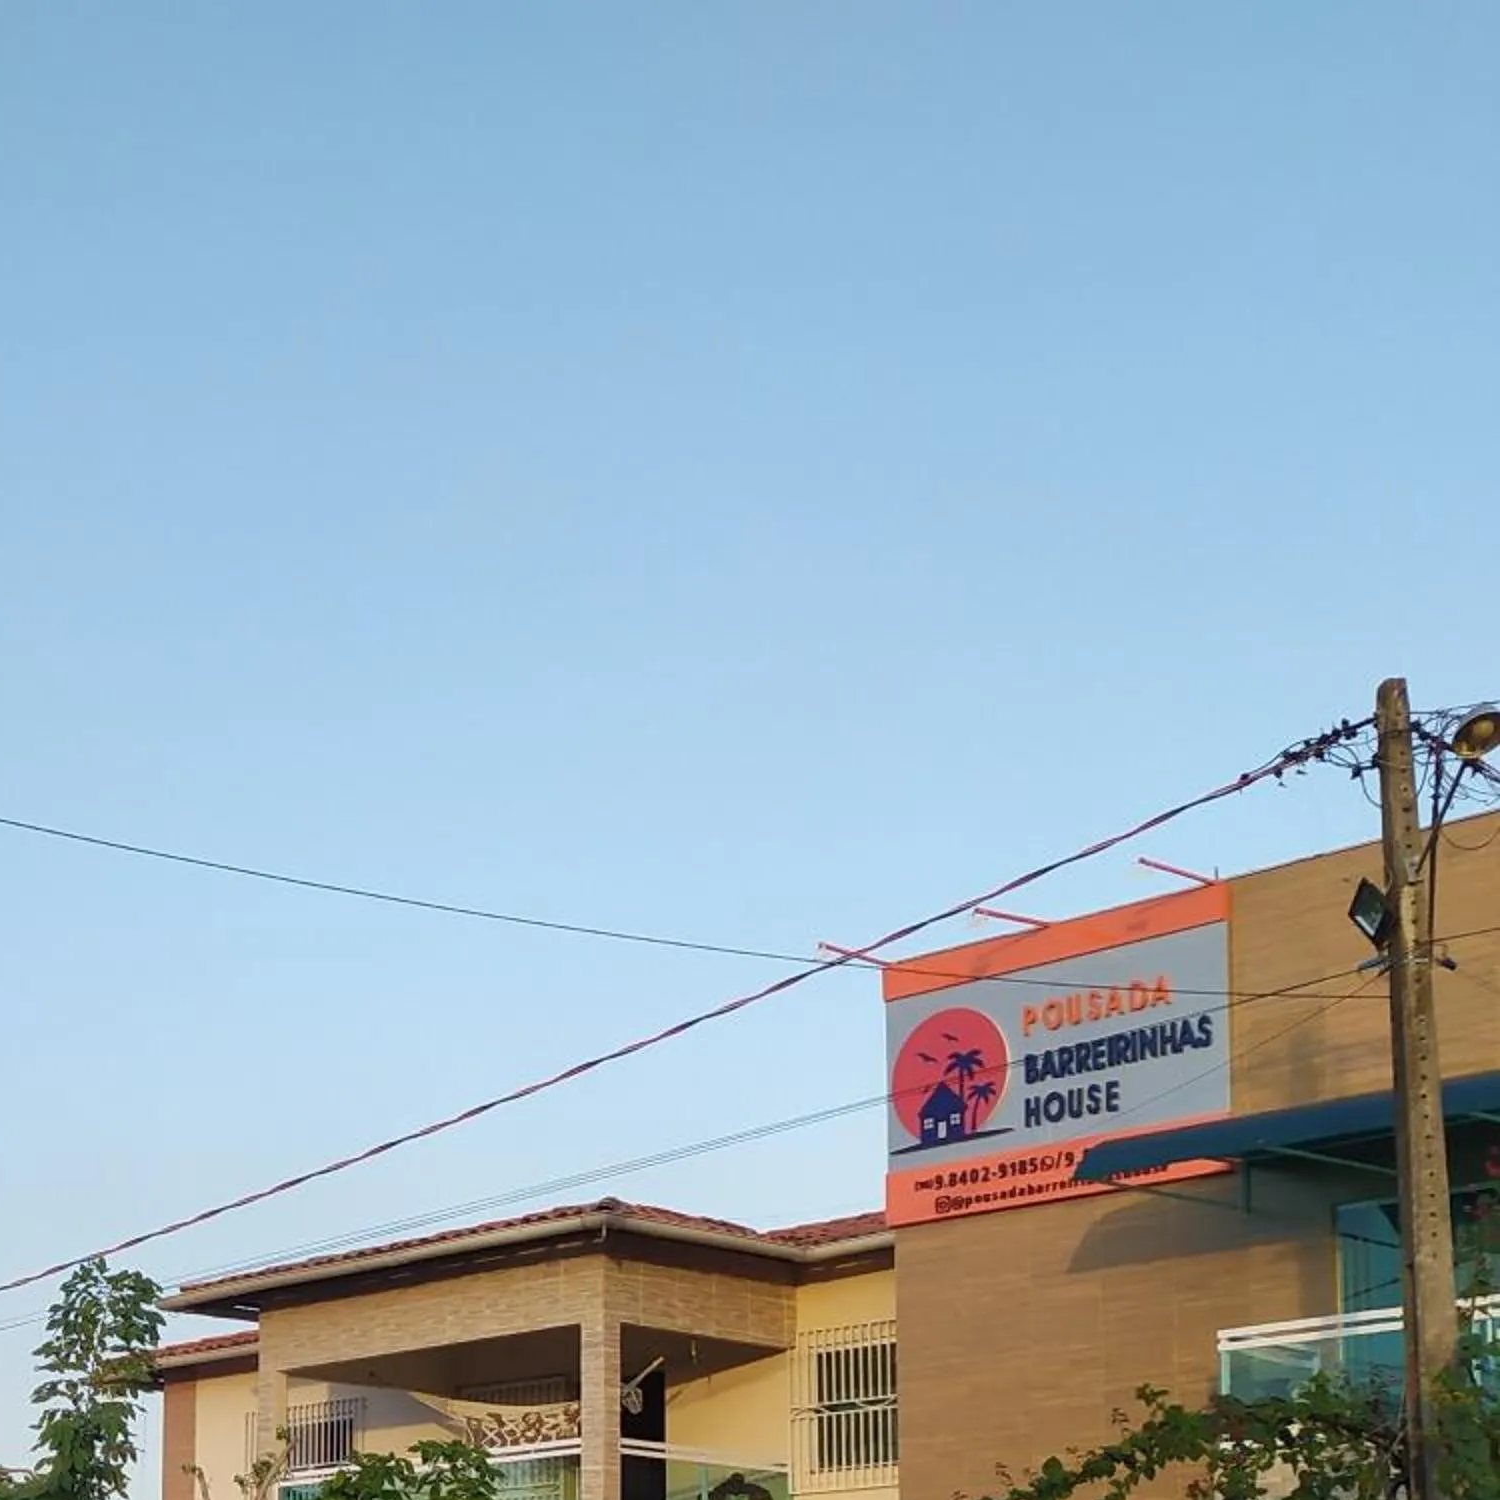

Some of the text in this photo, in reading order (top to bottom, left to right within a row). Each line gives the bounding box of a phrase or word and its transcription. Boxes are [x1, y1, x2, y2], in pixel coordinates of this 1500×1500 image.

[1021, 975, 1173, 1037] POUSADA
[1024, 1014, 1213, 1084] BARREIRINHAS
[1024, 1080, 1120, 1128] HOUSE
